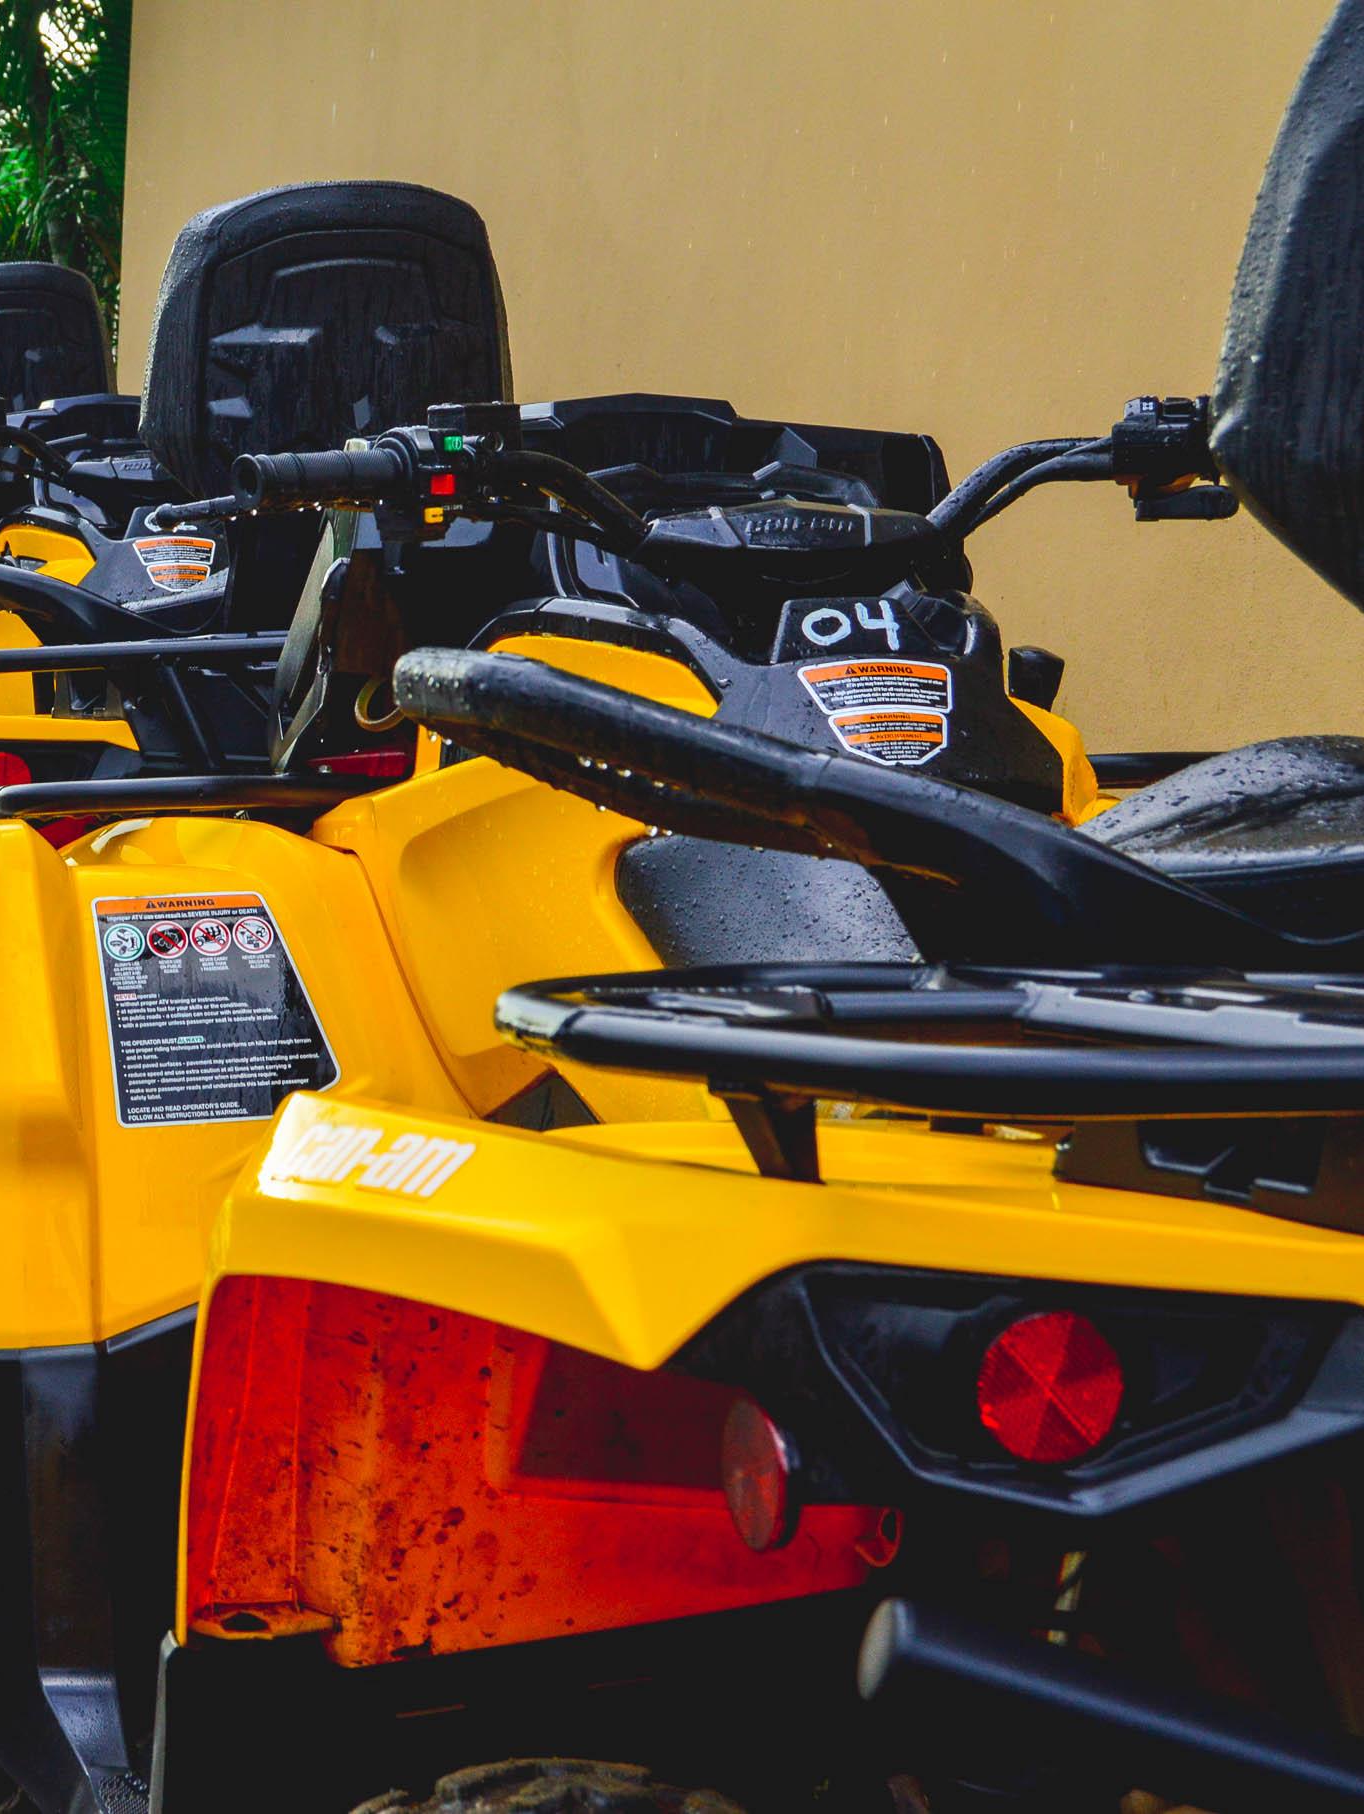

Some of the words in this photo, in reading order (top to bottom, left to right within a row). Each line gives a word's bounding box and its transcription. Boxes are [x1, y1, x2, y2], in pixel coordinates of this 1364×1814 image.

[801, 600, 900, 651] 04
[858, 665, 913, 674] WARNING
[157, 899, 215, 908] WARNING
[182, 1103, 219, 1111] OPERATOR'S
[166, 1111, 209, 1119] INSTRUCTIONS
[289, 1124, 476, 1197] can-am
